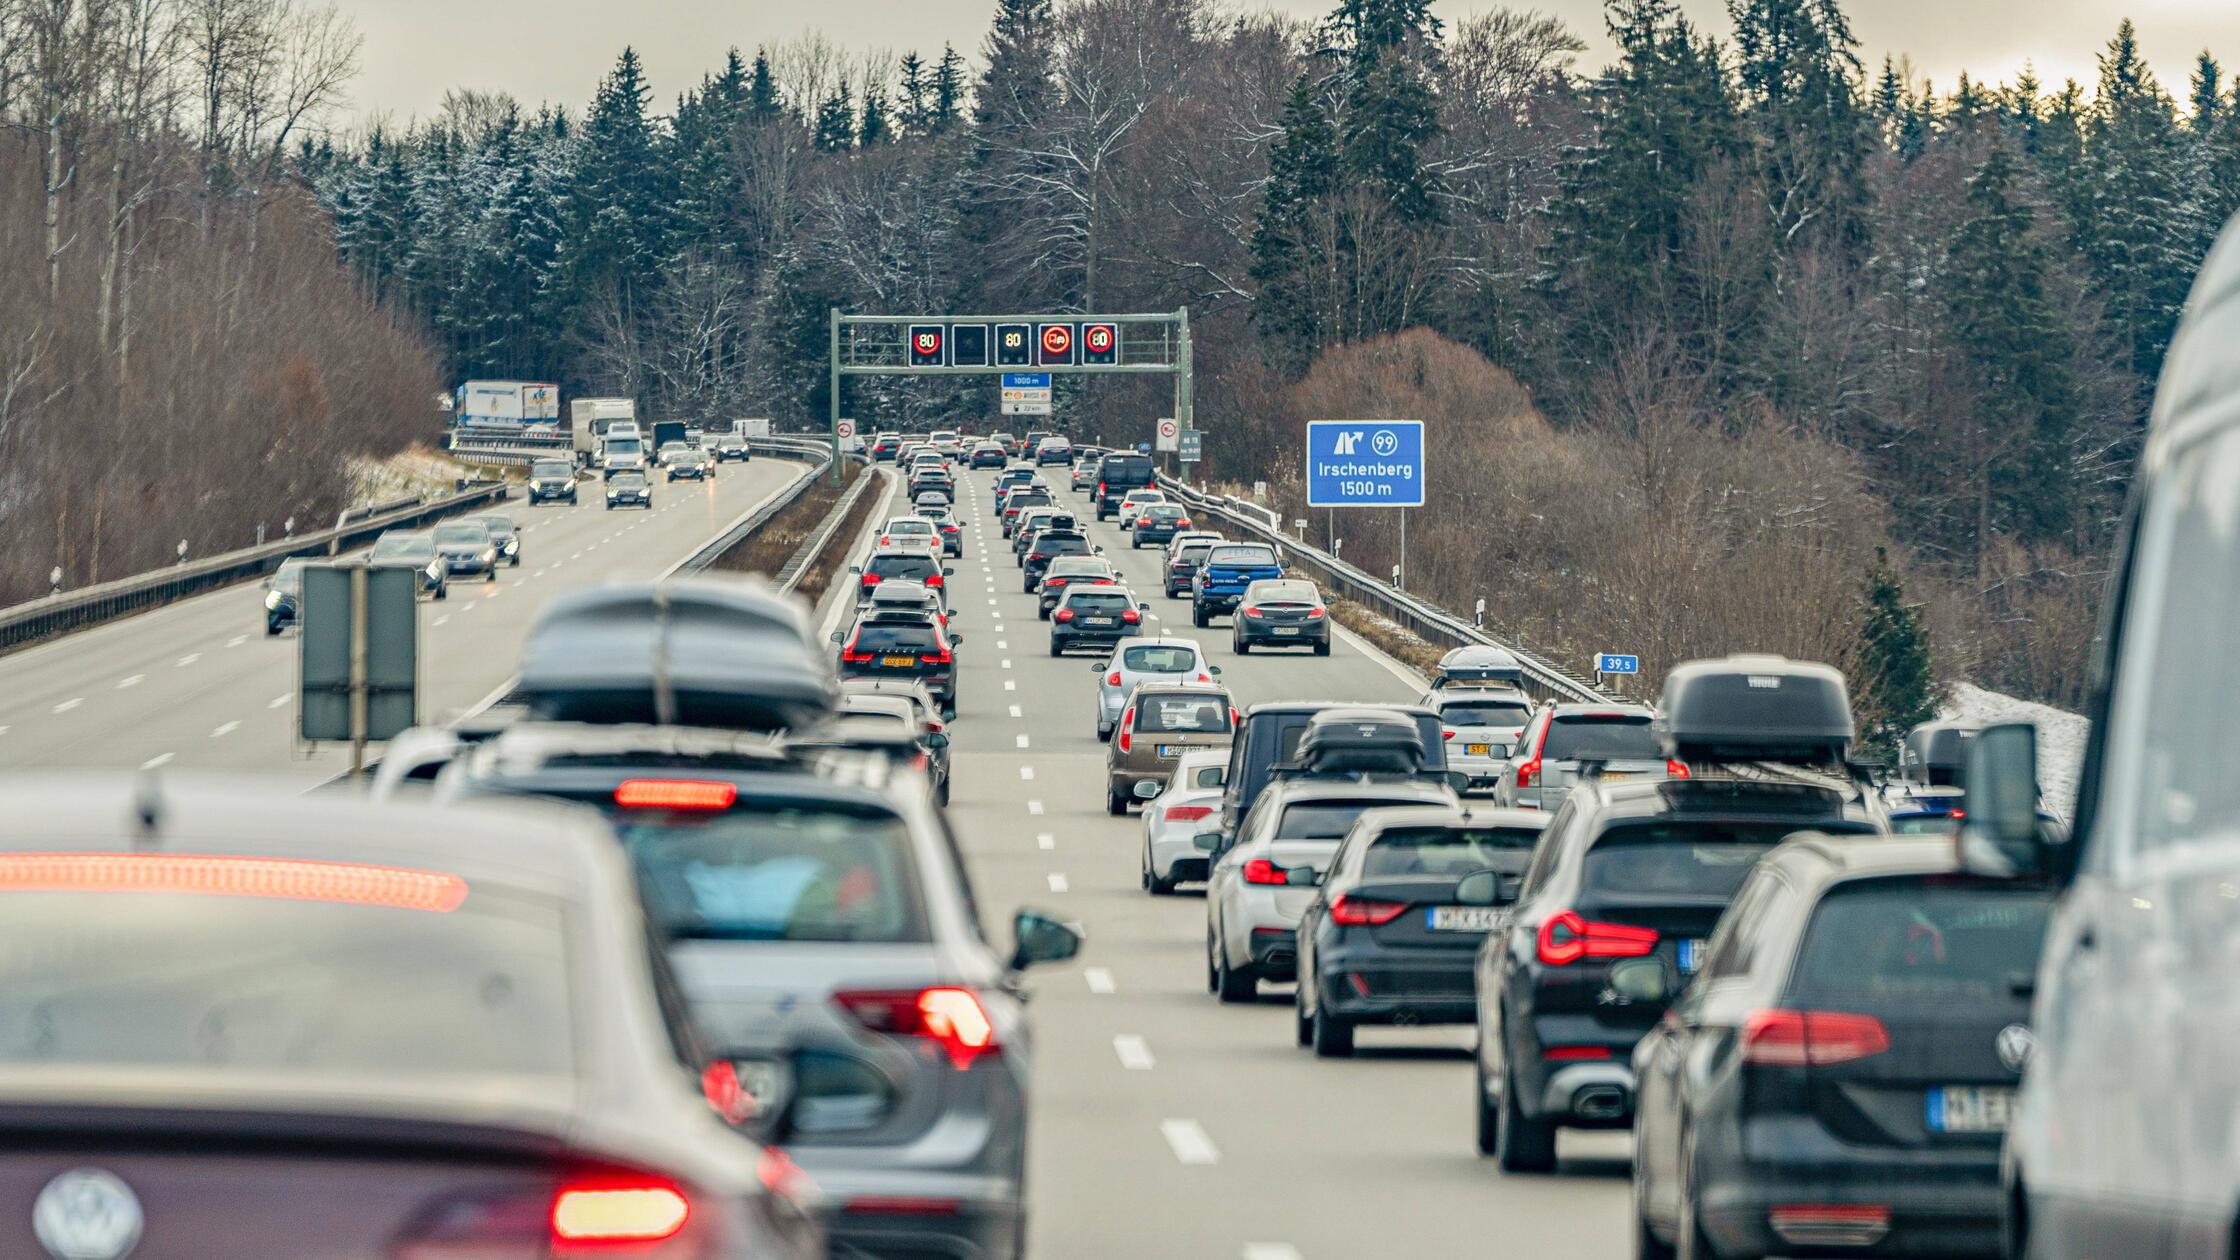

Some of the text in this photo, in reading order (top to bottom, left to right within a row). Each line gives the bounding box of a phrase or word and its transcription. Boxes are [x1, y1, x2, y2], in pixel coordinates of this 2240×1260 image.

[919, 334, 934, 347] 80
[1005, 333, 1021, 347] 80
[1092, 333, 1107, 347] 80
[1376, 436, 1394, 450] 99
[1319, 461, 1413, 480] Irschenberg
[1340, 481, 1392, 496] 1500 m
